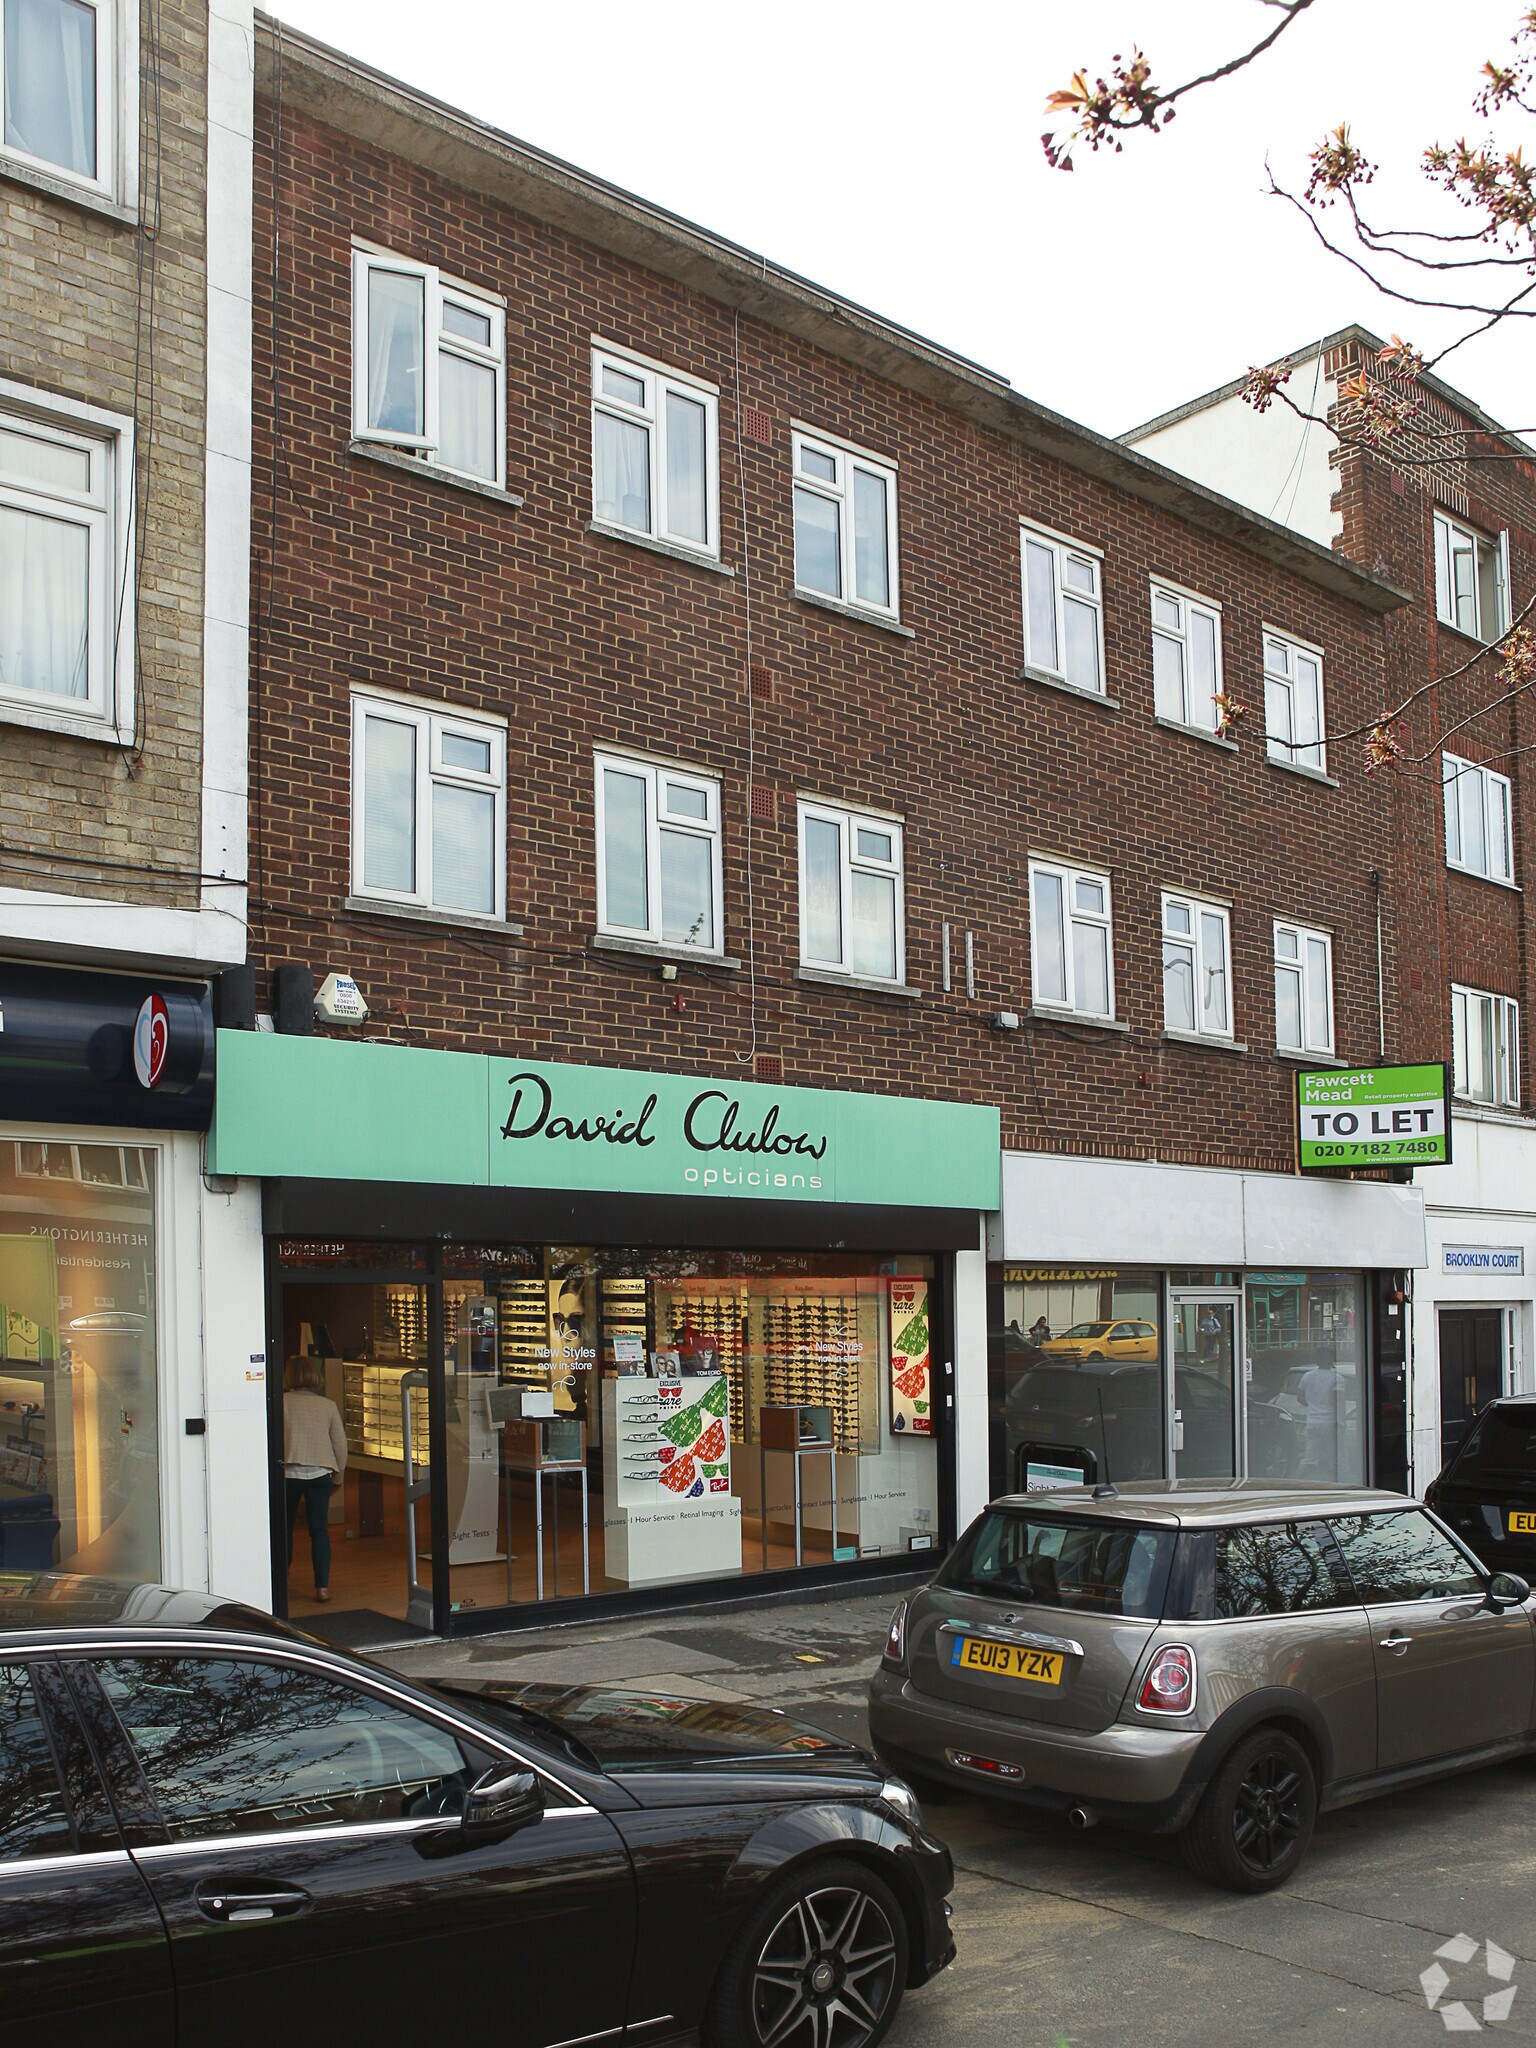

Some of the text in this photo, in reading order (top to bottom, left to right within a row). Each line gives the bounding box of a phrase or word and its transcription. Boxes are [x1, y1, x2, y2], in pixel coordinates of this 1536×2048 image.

[1305, 1073, 1375, 1088] Fawcett
[1305, 1088, 1353, 1102] Mead
[500, 1073, 827, 1160] David Clulow
[1311, 1109, 1434, 1137] TO LET
[1314, 1141, 1438, 1157] 020 7182 7480
[684, 1167, 823, 1188] opticians
[497, 1252, 537, 1266] CHANEL
[1446, 1253, 1519, 1268] BROOKLYN COURT
[892, 1301, 915, 1310] rare
[534, 1346, 596, 1359] New Styles
[815, 1341, 863, 1353] New Styles
[559, 1361, 593, 1370] in-store
[635, 1515, 652, 1523] Hour
[653, 1514, 675, 1522] Service
[680, 1510, 700, 1519] Retinal
[701, 1508, 724, 1518] Imaging
[797, 1500, 818, 1509] Contact
[819, 1499, 837, 1507] Lenses
[840, 1495, 867, 1505] Sunglasses
[888, 1490, 907, 1498] Service
[452, 1530, 490, 1541] Sight Tests
[967, 1642, 1055, 1678] EU13 YZK
